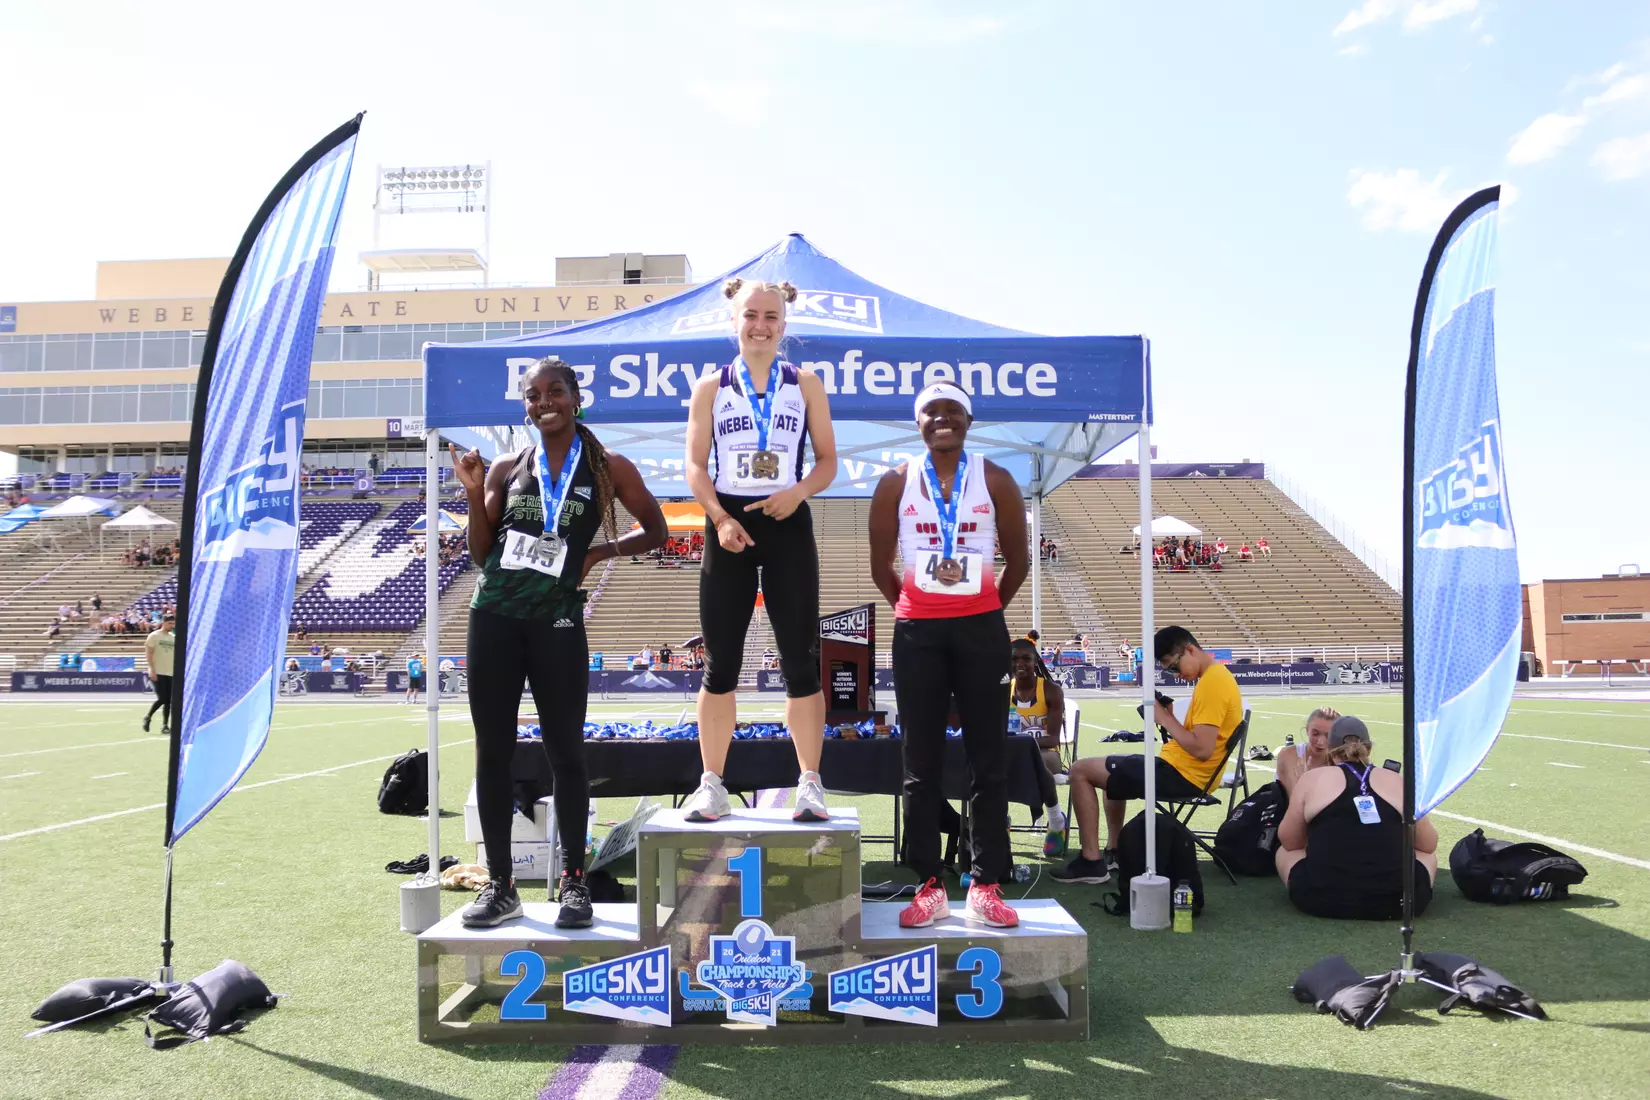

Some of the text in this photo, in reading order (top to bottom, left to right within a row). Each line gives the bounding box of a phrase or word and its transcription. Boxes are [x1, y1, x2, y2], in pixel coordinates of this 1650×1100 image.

[99, 306, 213, 324] WEBE
[388, 421, 400, 432] 10
[358, 479, 369, 490] D
[925, 553, 970, 584] 41
[44, 677, 70, 685] WEBER
[70, 677, 93, 685] STATE
[728, 847, 762, 917] 1
[732, 954, 771, 964] Outdoor
[701, 965, 801, 981] CHAMPIONSHIPS
[500, 950, 547, 1019] 2
[717, 980, 788, 989] Track & Field
[956, 947, 1004, 1019] 3
